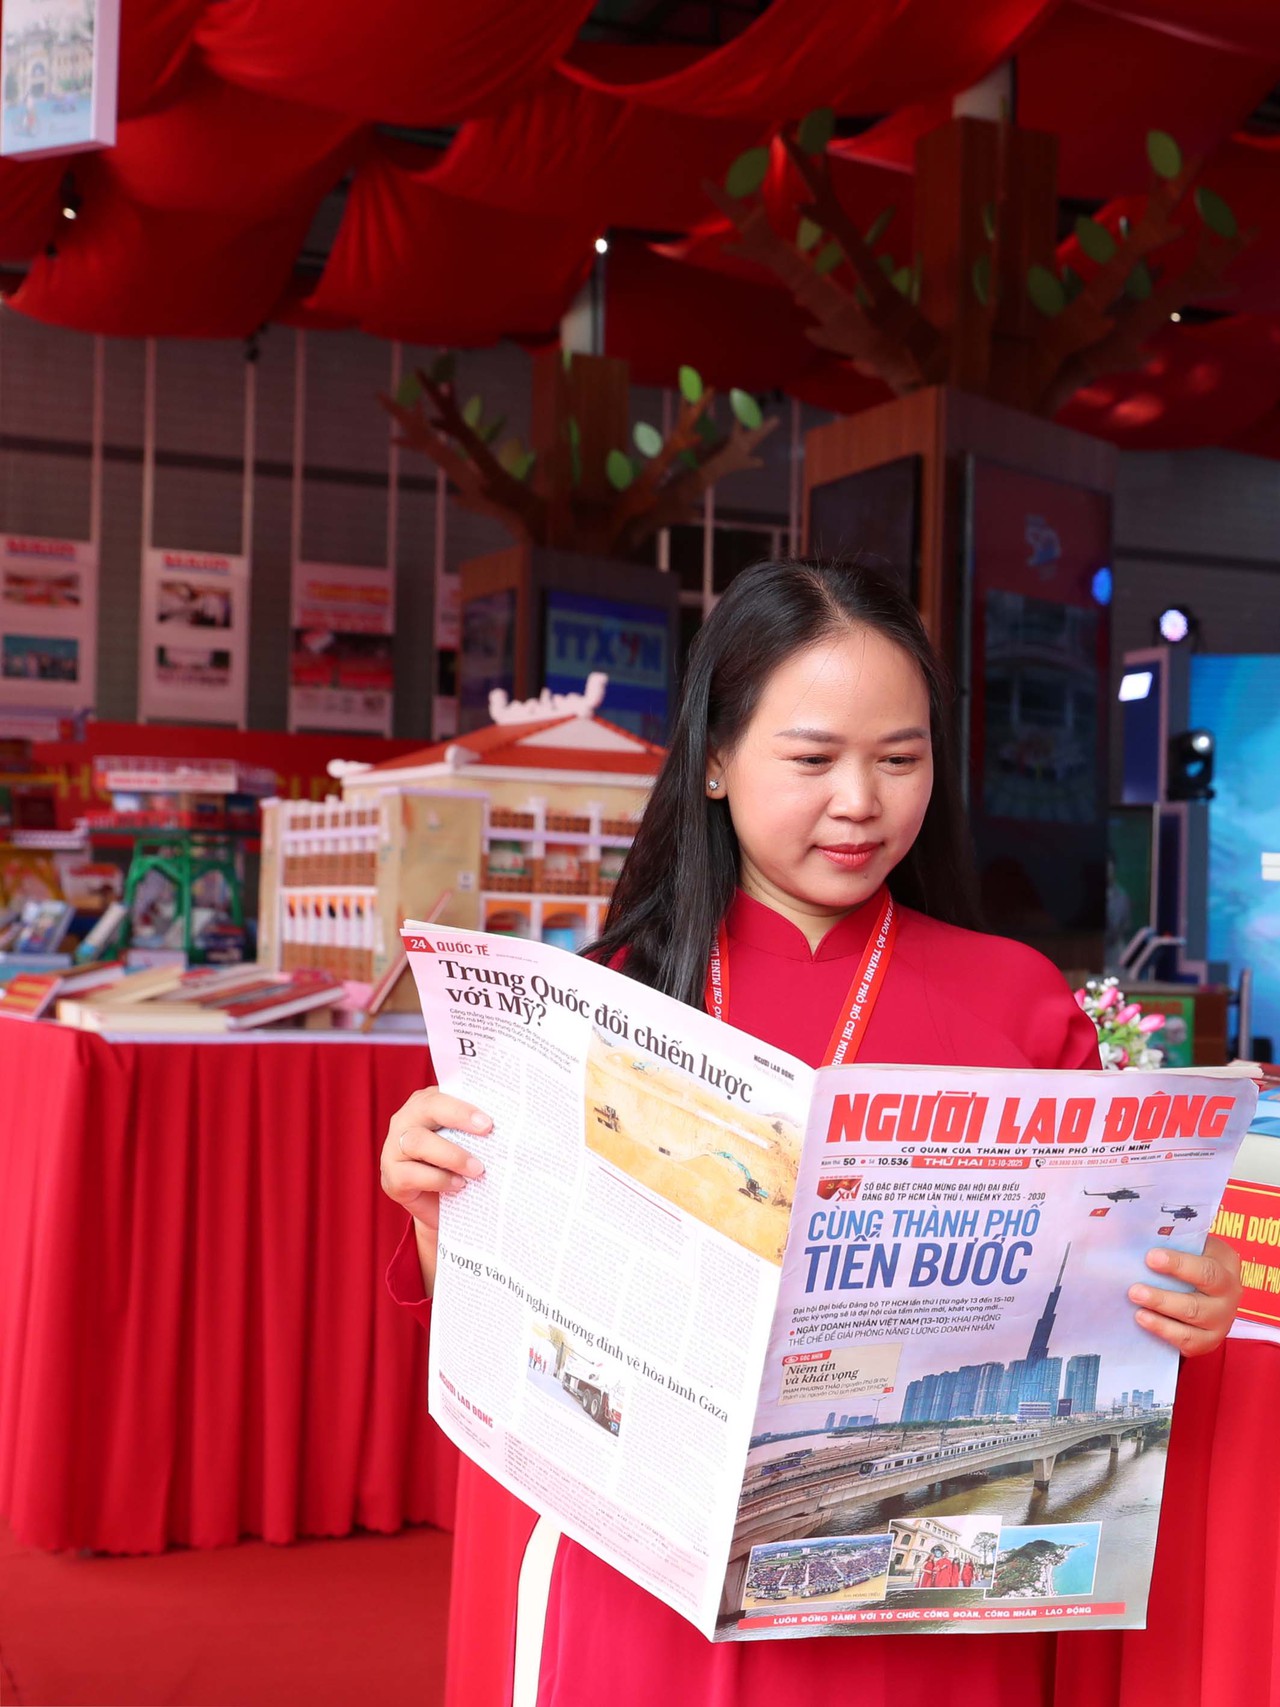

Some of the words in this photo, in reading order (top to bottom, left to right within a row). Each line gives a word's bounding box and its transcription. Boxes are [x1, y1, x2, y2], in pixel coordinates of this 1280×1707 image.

[410, 938, 427, 950] 24
[436, 941, 473, 954] QUỐC
[474, 944, 491, 957] TẾ
[876, 935, 887, 949] BỘ
[711, 958, 721, 985] MINH
[863, 948, 882, 983] THÀNH
[445, 986, 494, 1009] với
[496, 991, 547, 1027] Mỹ?
[714, 986, 723, 1005] CHÍ
[438, 959, 527, 997] Trung
[531, 975, 590, 1019] Quốc
[594, 1002, 630, 1040] đổi
[634, 1026, 695, 1074] chiến
[698, 1053, 753, 1104] lược
[841, 1019, 856, 1040] CHÍ
[831, 1039, 849, 1066] MINH
[826, 1091, 989, 1143] NGƯỜI
[995, 1097, 1096, 1144] LAO
[1101, 1090, 1236, 1143] ĐỘNG
[843, 1157, 856, 1166] 50
[878, 1157, 909, 1166] 10.536
[924, 1156, 953, 1166] THỨ
[957, 1158, 983, 1166] HAI
[987, 1159, 1023, 1167] 13-10-2025
[808, 1206, 884, 1242] CÙNG
[892, 1205, 980, 1238] THÀNH
[984, 1202, 1044, 1237] PHỐ
[804, 1231, 901, 1293] TIẾN
[908, 1234, 1033, 1288] BƯỚC
[1240, 1256, 1266, 1290] THÀNH
[450, 1252, 483, 1276] vọng
[485, 1264, 507, 1285] vào
[508, 1276, 525, 1300] hội
[526, 1293, 550, 1319] nghị
[551, 1308, 594, 1347] thượng
[596, 1336, 623, 1361] đỉnh
[626, 1354, 640, 1371] về
[642, 1361, 665, 1385] hòa
[667, 1376, 696, 1403] bình
[699, 1395, 729, 1423] Gaza
[785, 1373, 799, 1386] và
[801, 1372, 829, 1384] khát
[832, 1369, 859, 1382] vọng
[786, 1363, 817, 1376] Niềm
[821, 1362, 836, 1371] tin
